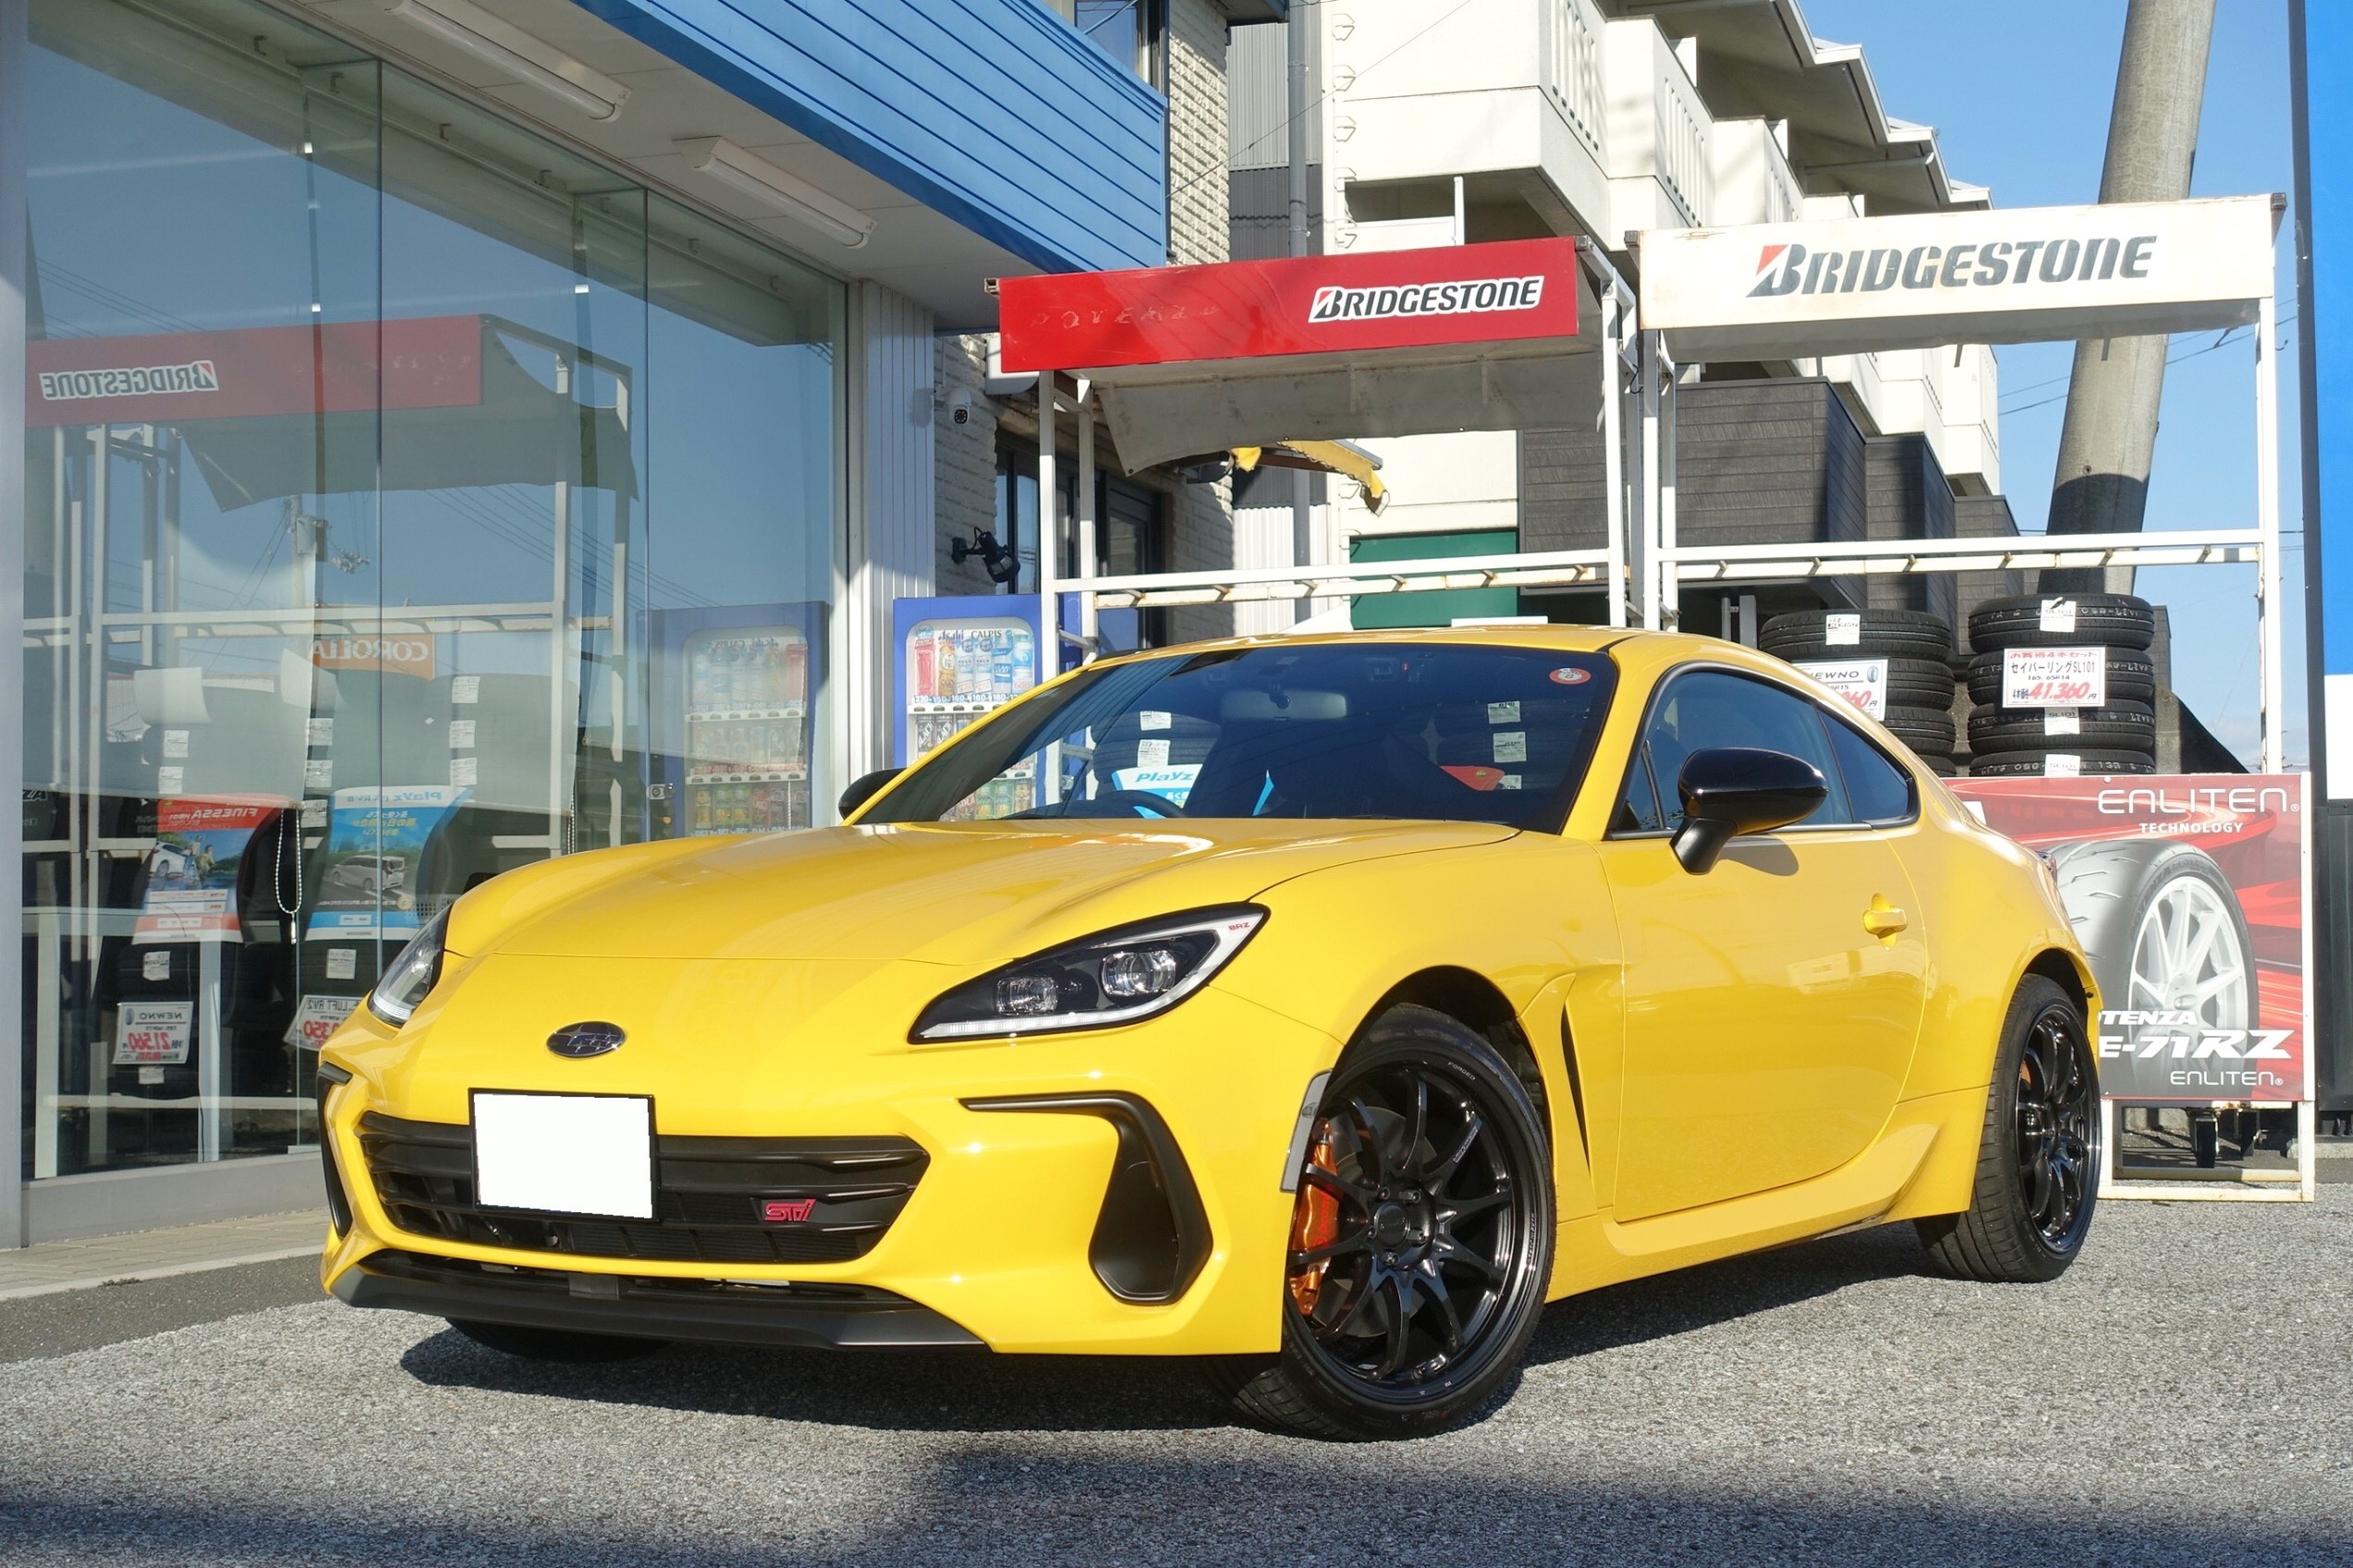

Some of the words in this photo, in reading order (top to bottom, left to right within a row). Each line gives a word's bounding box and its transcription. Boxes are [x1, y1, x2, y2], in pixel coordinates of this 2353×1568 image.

[1745, 235, 2158, 298] BRIDGESTONE
[1312, 278, 1540, 320] BRIDGESTONE
[938, 629, 965, 640] Asahi
[2011, 661, 2095, 674] セイバーリングSL101
[1136, 770, 1194, 783] Playz
[2140, 822, 2244, 833] TECHNOLOGY
[1228, 922, 1250, 930] BRZ
[2098, 1010, 2198, 1026] TENZA
